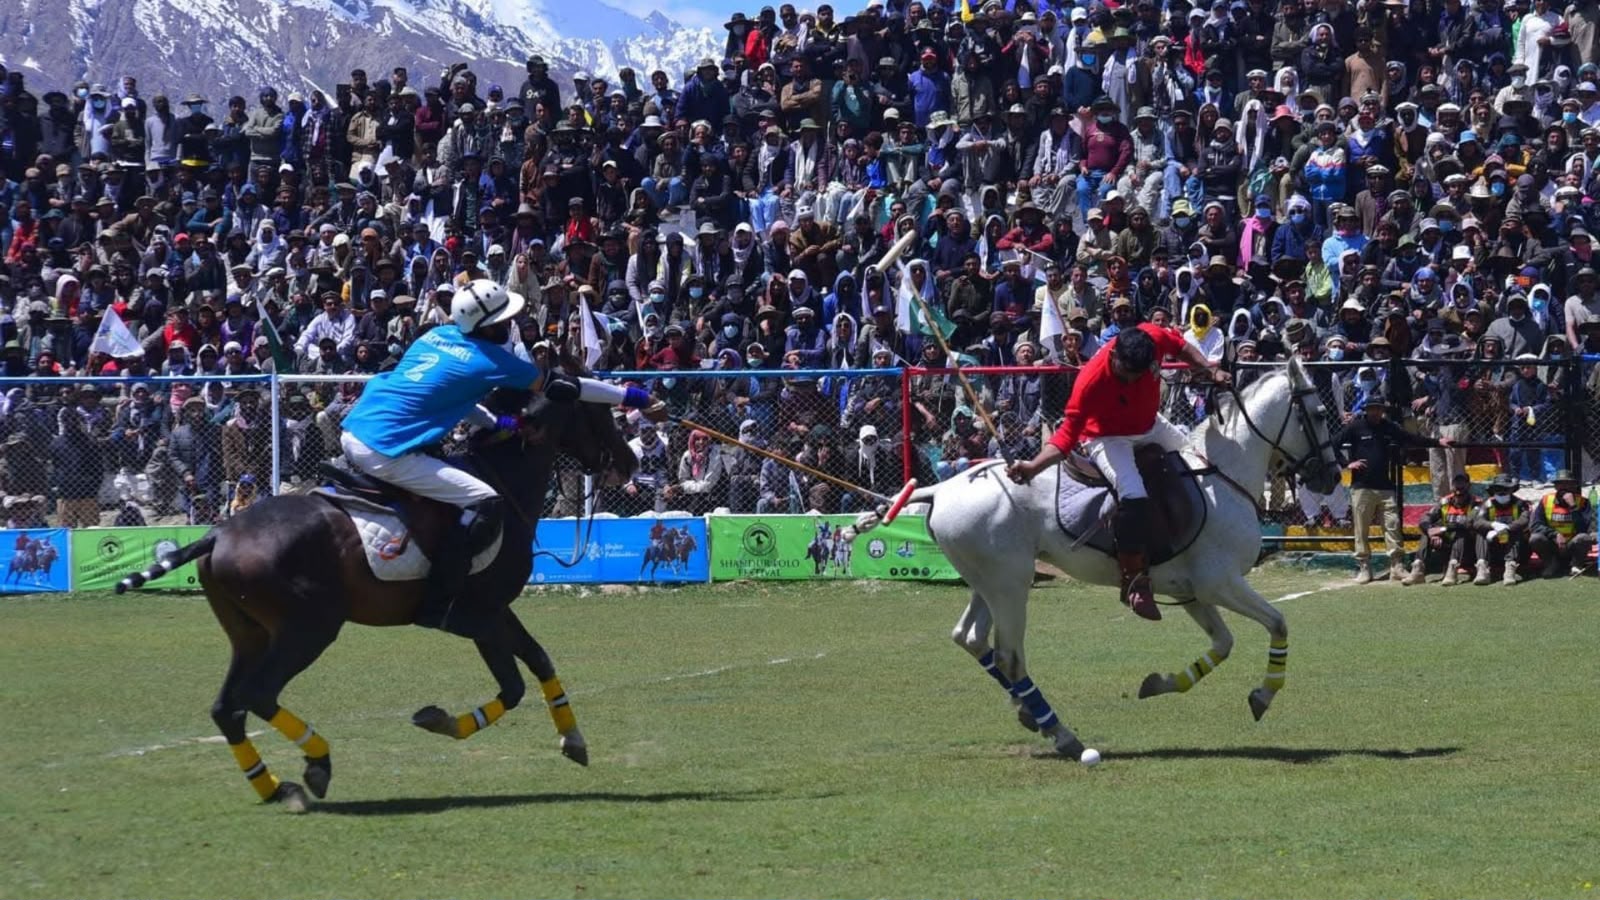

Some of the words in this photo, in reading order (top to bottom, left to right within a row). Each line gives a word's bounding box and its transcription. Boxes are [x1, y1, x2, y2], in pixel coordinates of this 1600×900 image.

[404, 353, 440, 382] 2
[720, 559, 772, 569] SHANDUR
[773, 559, 801, 569] POLO
[738, 568, 781, 577] FESTIVAL
